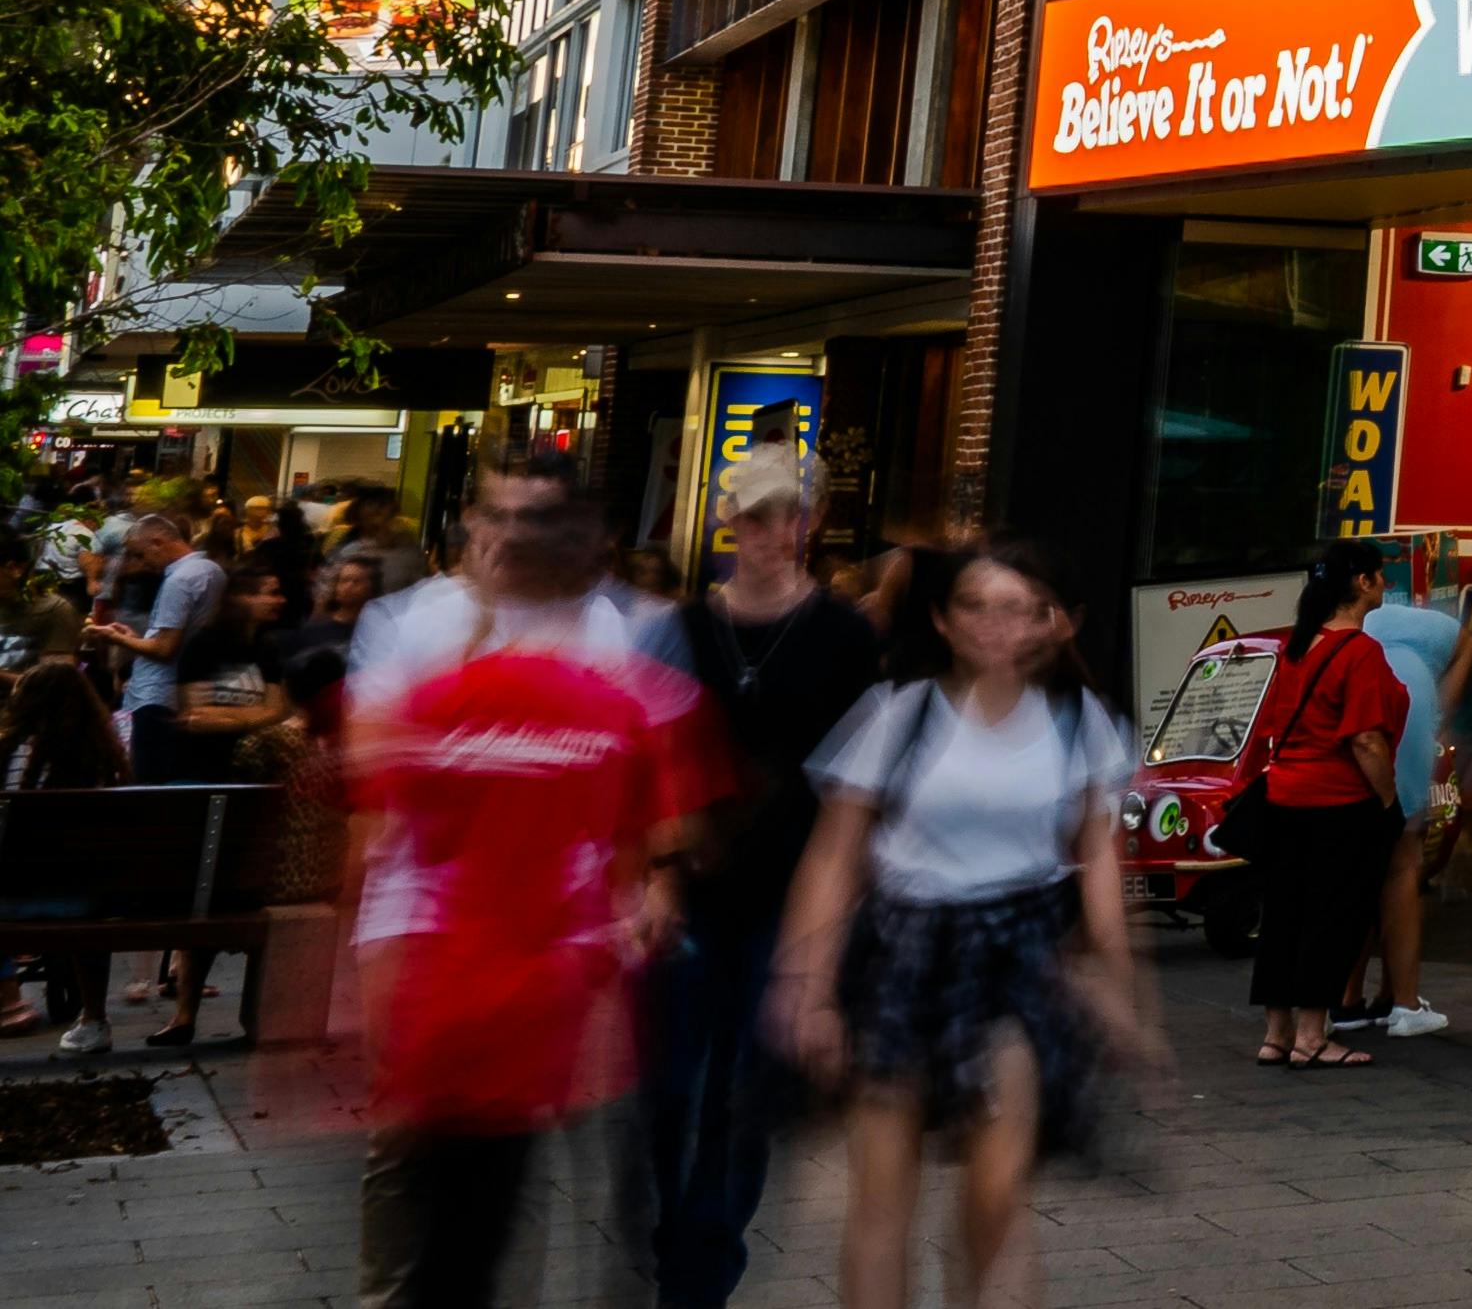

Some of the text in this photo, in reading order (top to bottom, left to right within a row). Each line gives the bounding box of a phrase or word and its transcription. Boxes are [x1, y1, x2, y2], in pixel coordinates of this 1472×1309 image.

[1053, 32, 1367, 154] Believe It or Not!
[1087, 15, 1174, 86] Ripley's
